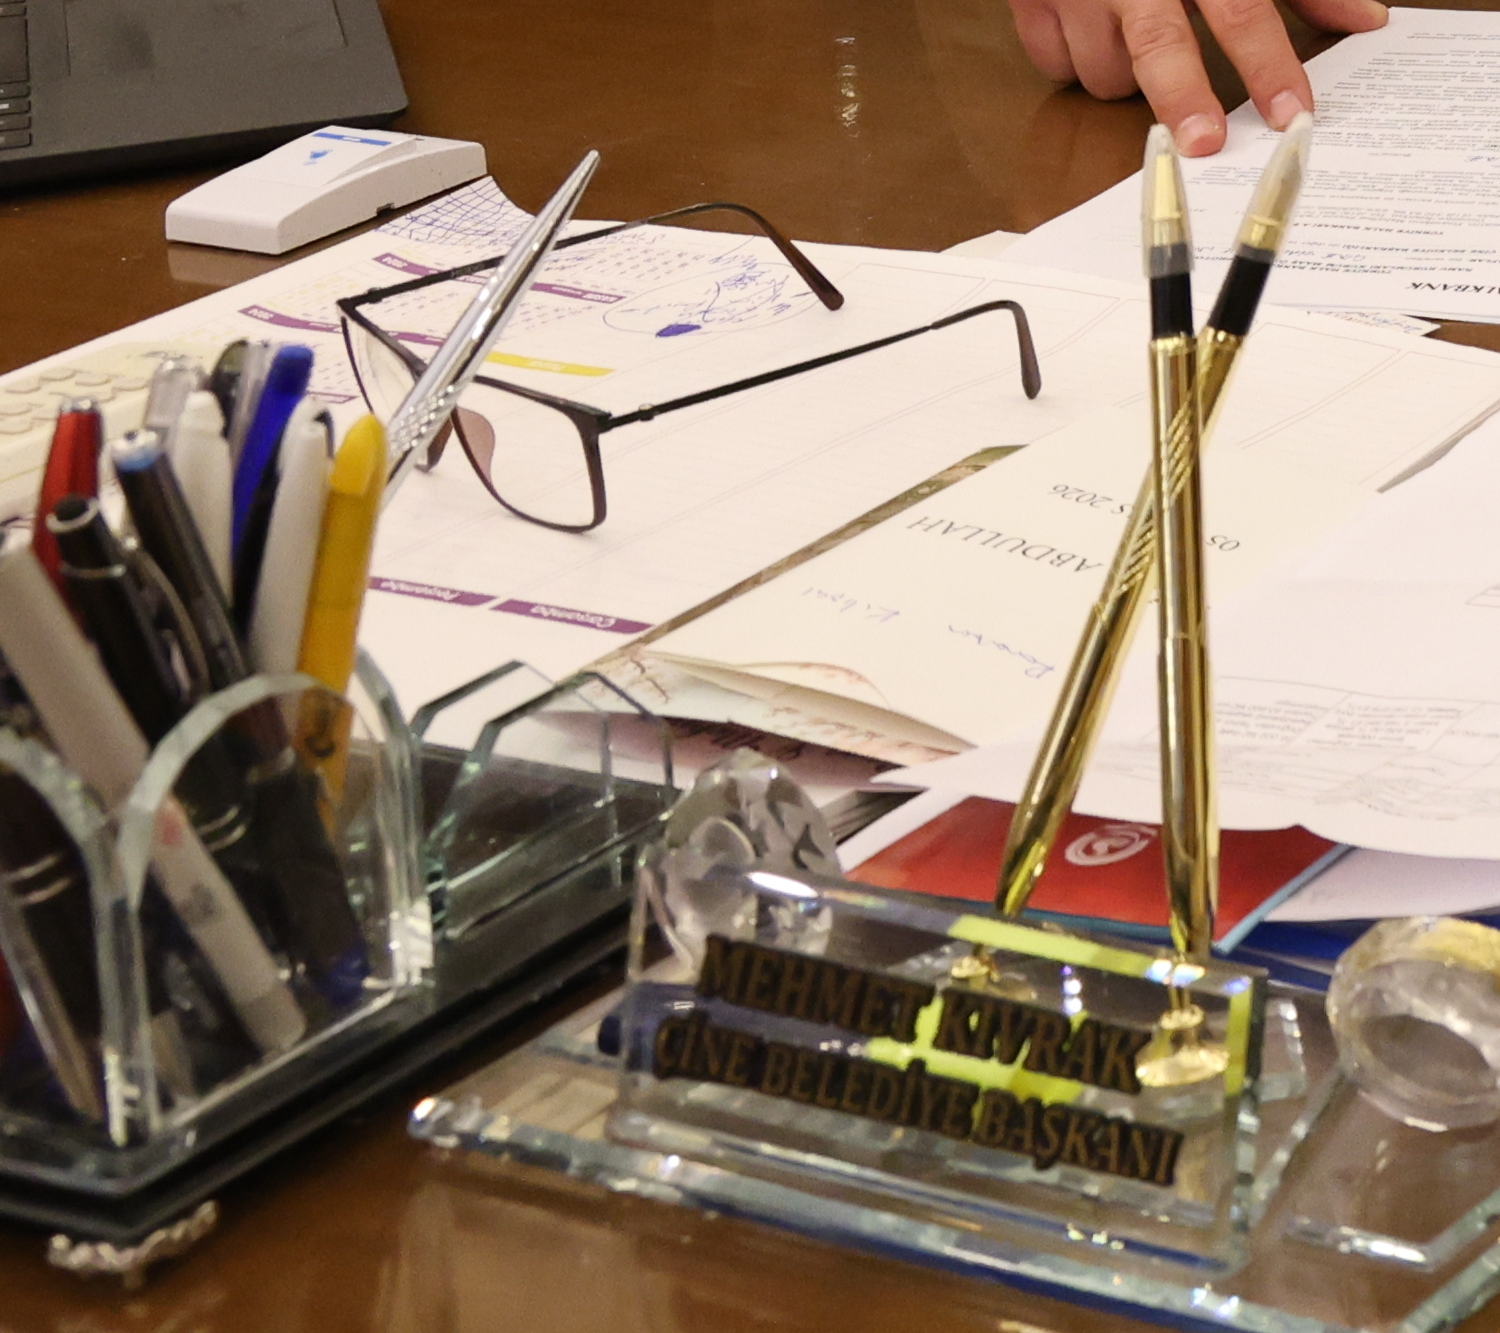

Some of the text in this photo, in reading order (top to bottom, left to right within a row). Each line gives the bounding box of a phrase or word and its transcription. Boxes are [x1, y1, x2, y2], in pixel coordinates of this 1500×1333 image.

[1047, 484, 1113, 510] 2026
[906, 516, 1105, 575] ABDULLAH
[1206, 534, 1241, 553] 05
[698, 935, 1152, 1093] MEHMET KIVRAK
[656, 1007, 1182, 1186] ÇİNE BELEDİYE BAŞKANI
